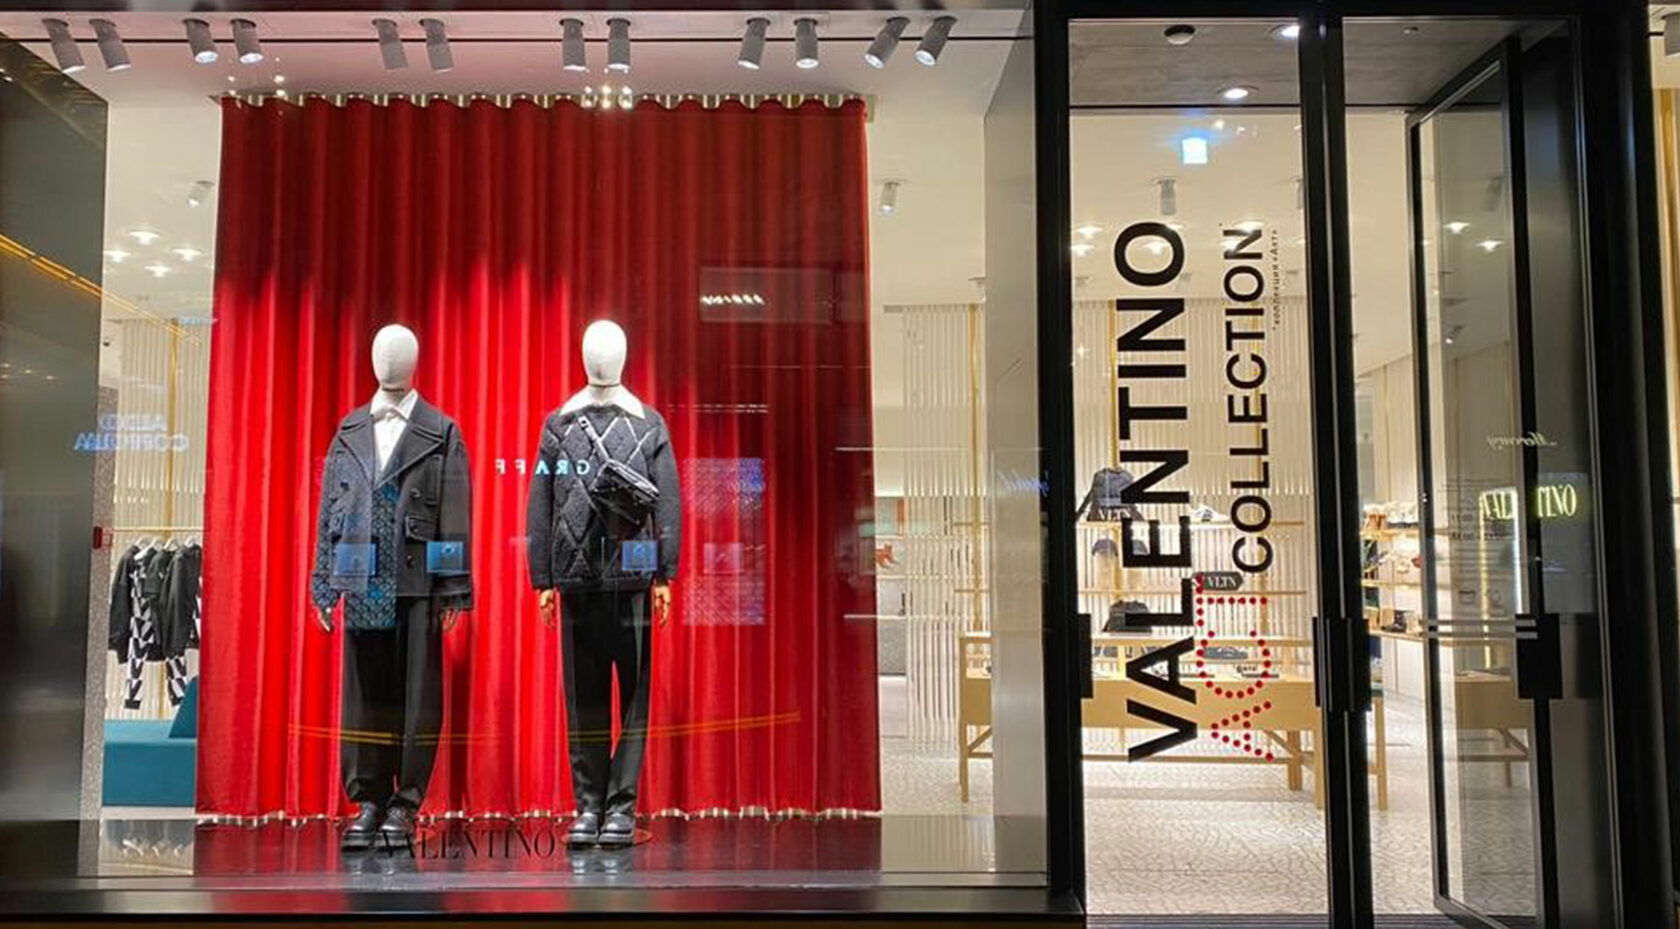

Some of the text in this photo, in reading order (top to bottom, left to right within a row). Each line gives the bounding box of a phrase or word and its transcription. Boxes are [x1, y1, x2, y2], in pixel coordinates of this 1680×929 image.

[1114, 222, 1197, 762] VALENTINO
[1196, 229, 1274, 761] ACT COLLECTION
[1207, 575, 1237, 588] VLTN
[380, 828, 556, 859] VALENTINO
